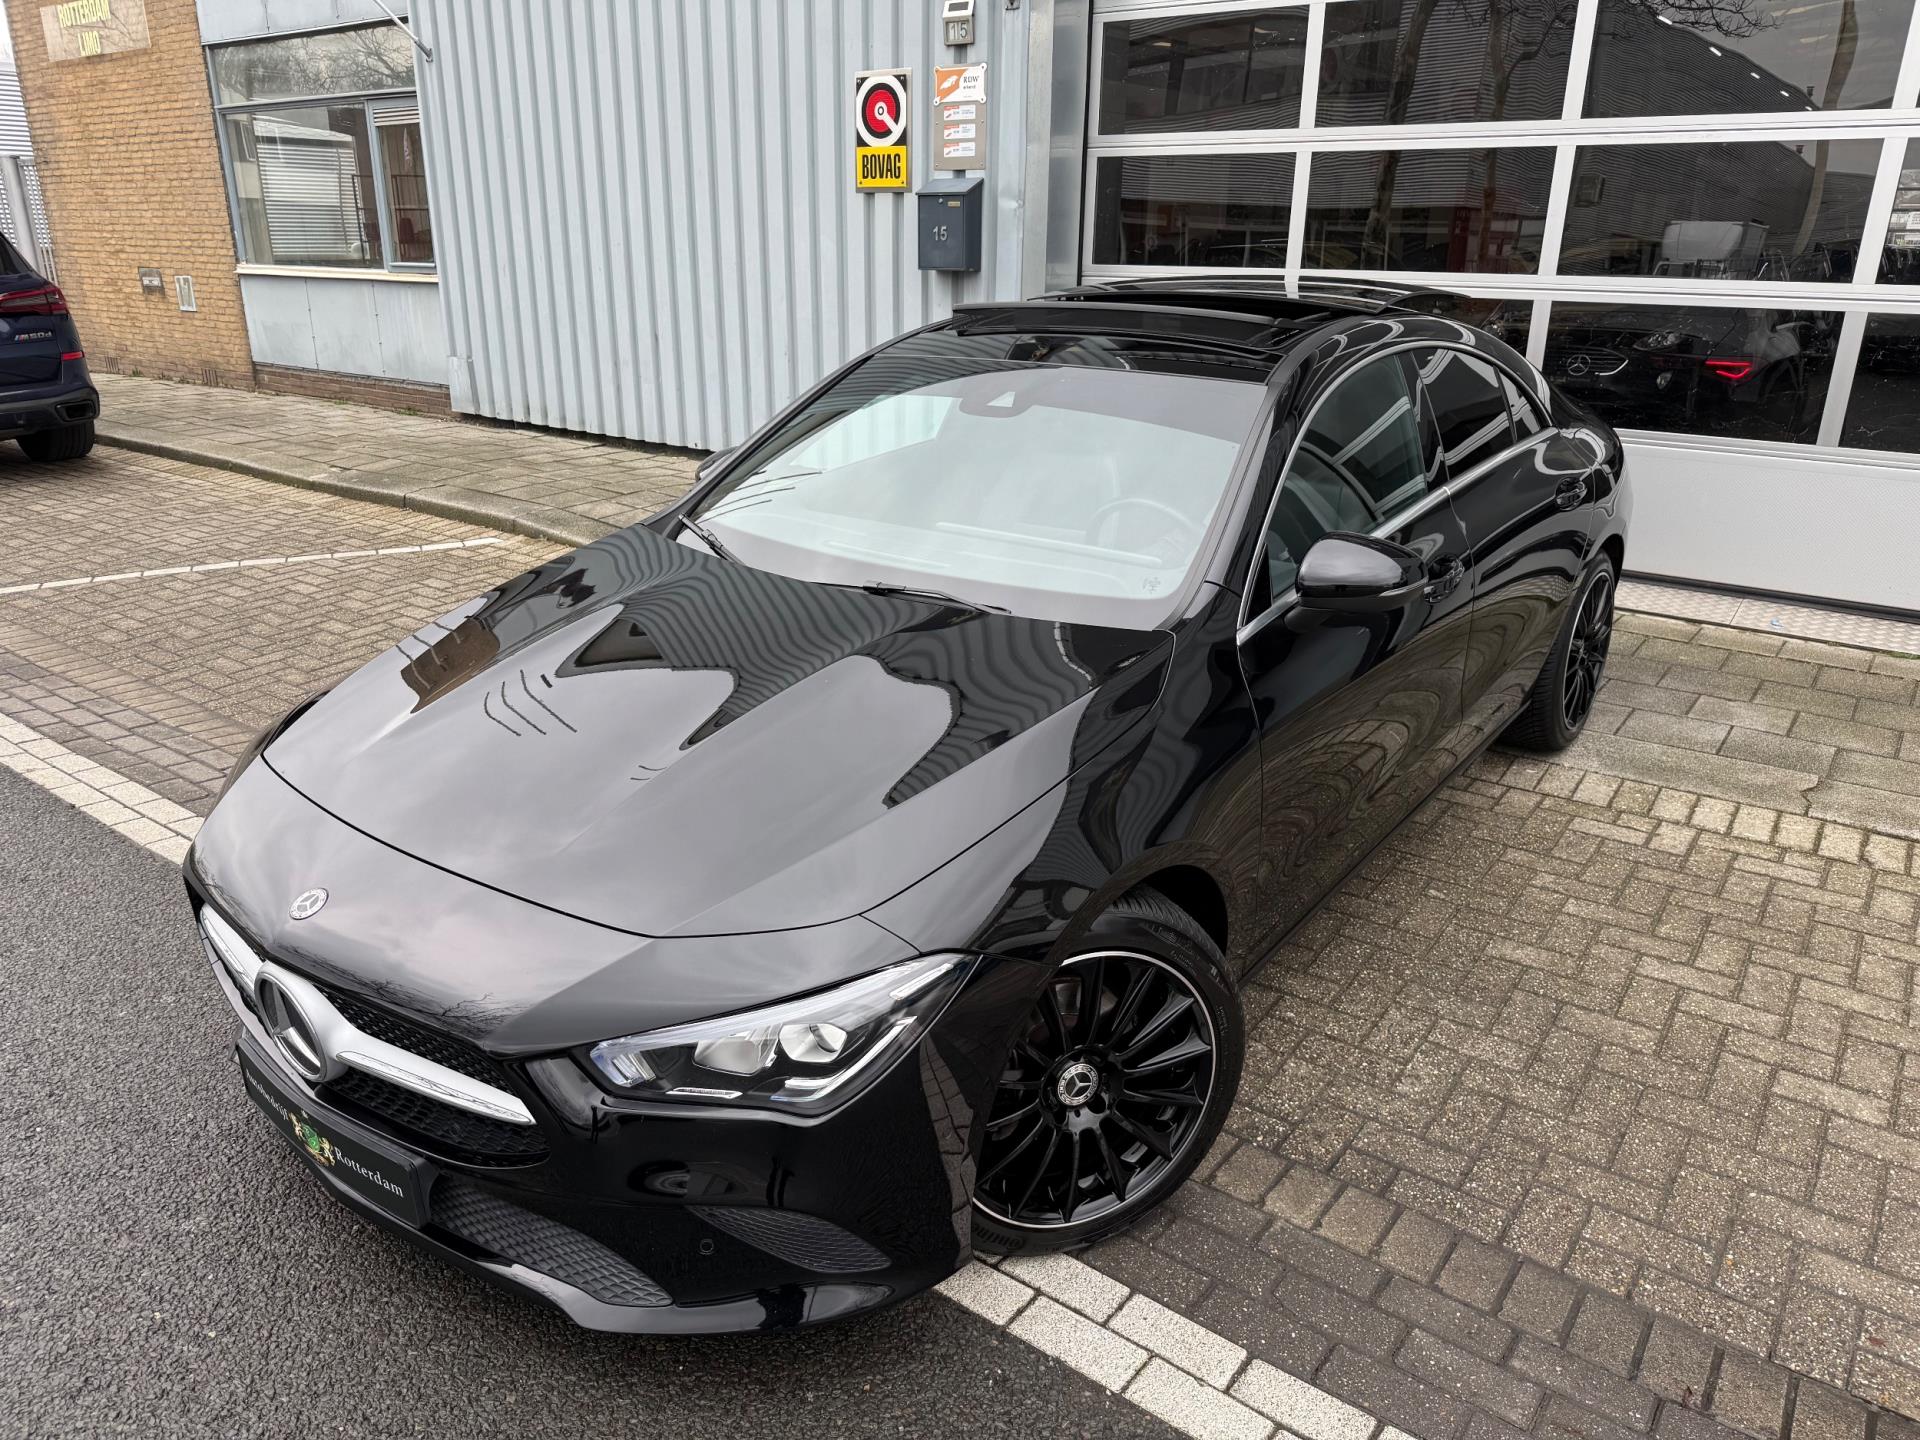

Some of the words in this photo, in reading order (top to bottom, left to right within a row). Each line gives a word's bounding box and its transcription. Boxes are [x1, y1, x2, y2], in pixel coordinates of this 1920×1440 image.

[57, 0, 111, 28] ROTTERDAM
[78, 31, 101, 56] LIMO
[950, 22, 968, 40] 15
[862, 153, 901, 179] BOVAG
[933, 226, 948, 241] 15
[334, 1146, 404, 1198] Rotterdam
